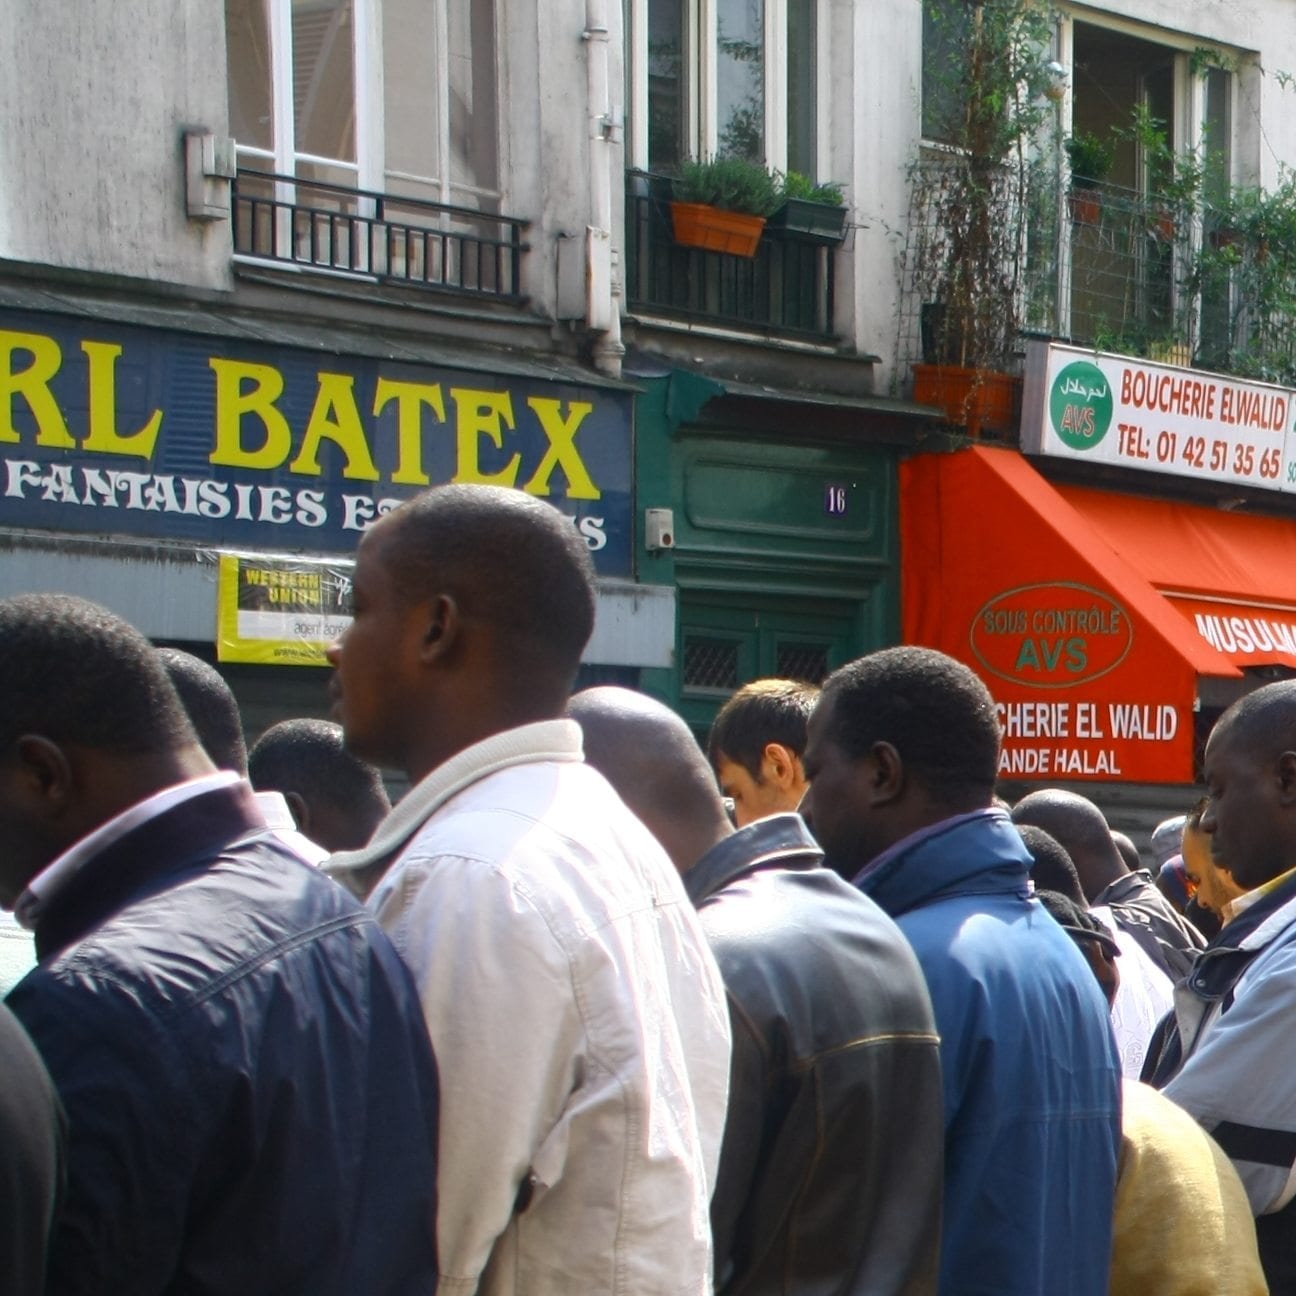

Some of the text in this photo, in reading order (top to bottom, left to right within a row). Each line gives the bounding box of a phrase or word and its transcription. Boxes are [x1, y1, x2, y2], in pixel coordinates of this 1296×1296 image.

[1121, 368, 1214, 421] BOUCHERIE
[208, 357, 601, 501] BATEX
[1061, 403, 1095, 438] AVS
[1118, 424, 1281, 479] TEL: 01 42 51 35 65
[5, 458, 328, 528] FANTAISIES
[829, 487, 845, 513] 16
[246, 568, 320, 589] WESTERN
[269, 588, 320, 607] UNION
[984, 605, 1120, 634] SOUS CONTRÔLE
[1016, 636, 1088, 673] AVS
[1076, 702, 1104, 739] EL
[1108, 703, 1177, 741] WALID
[998, 748, 1121, 775] ANDE HALAL
